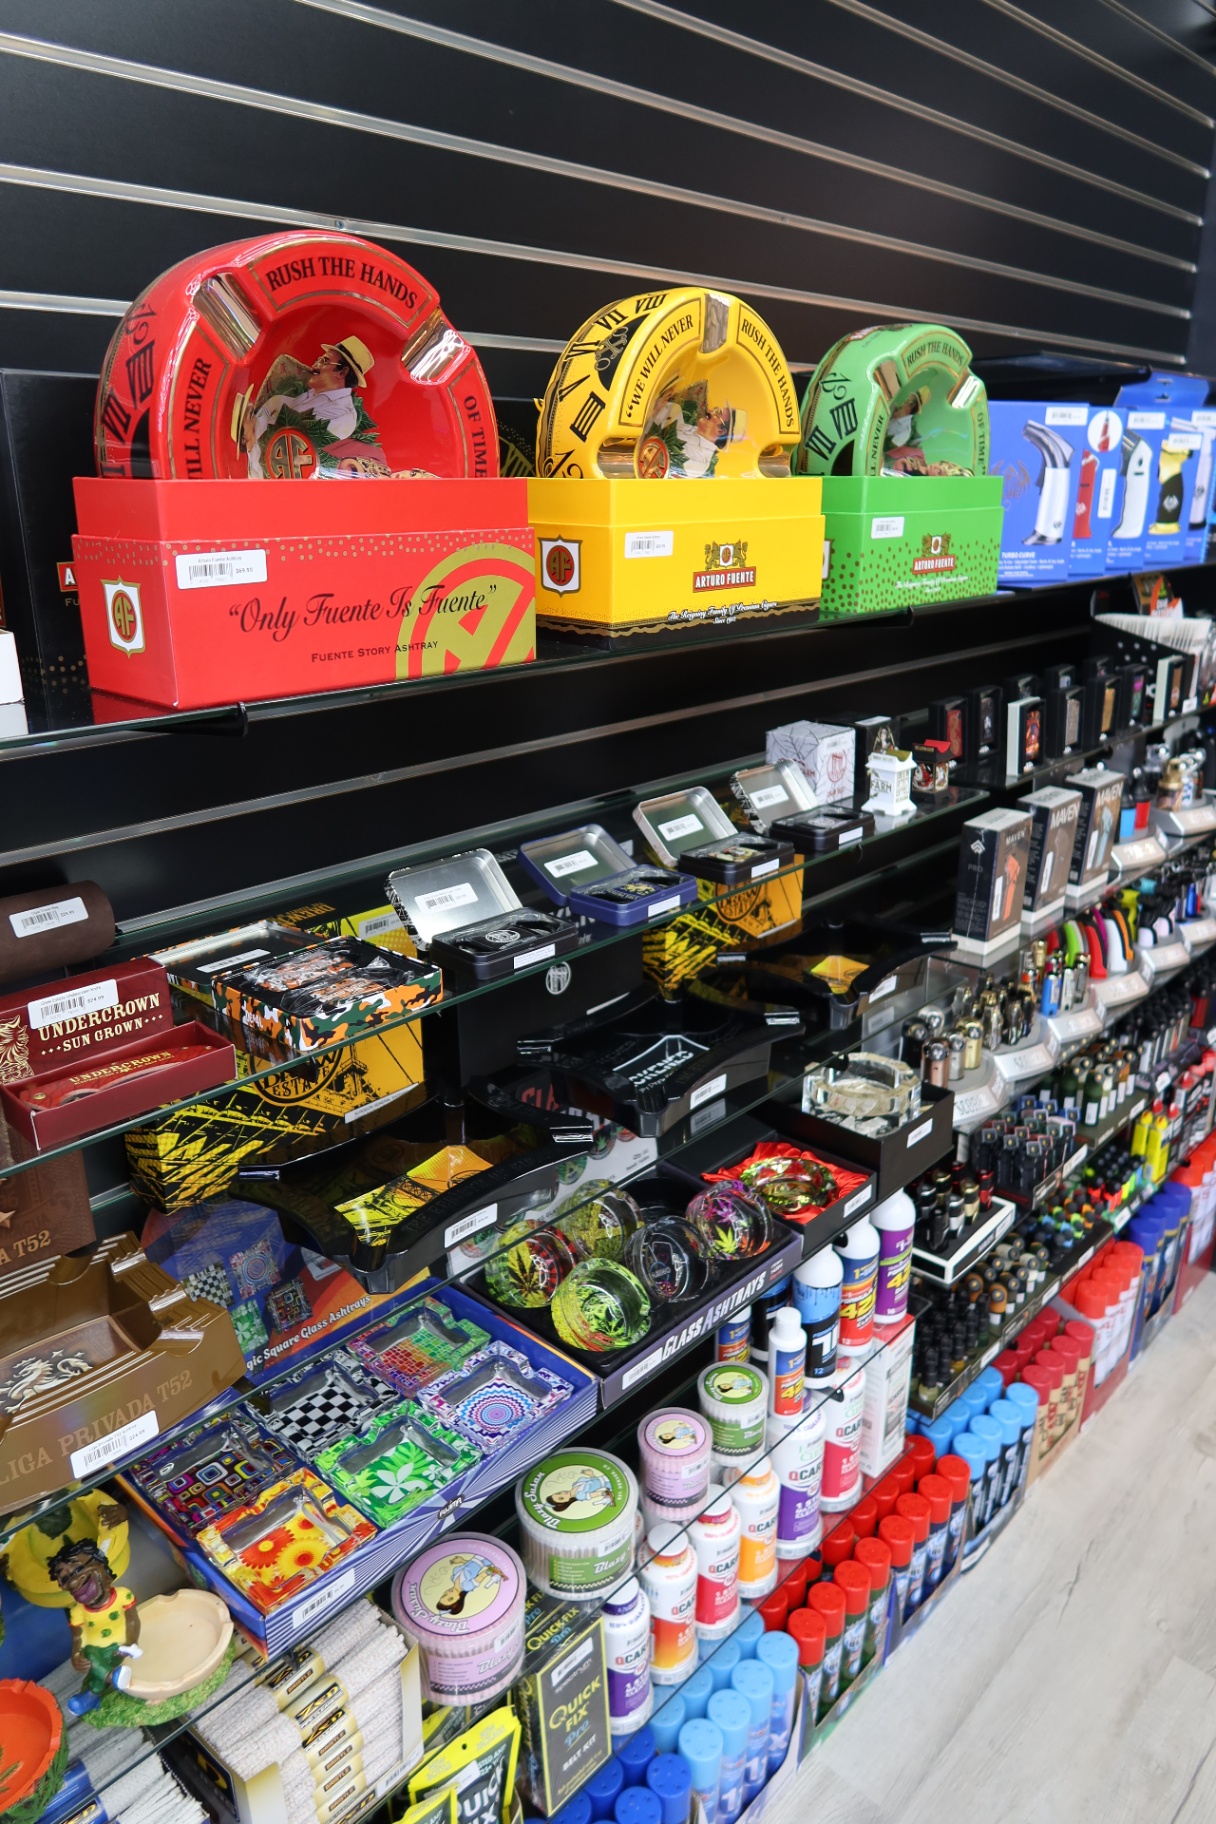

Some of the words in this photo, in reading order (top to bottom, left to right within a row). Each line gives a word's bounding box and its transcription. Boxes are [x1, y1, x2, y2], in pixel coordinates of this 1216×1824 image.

[265, 257, 316, 291] RUSH
[318, 256, 356, 279] THE
[360, 262, 418, 310] HANDS
[640, 346, 664, 380] WILL
[661, 314, 694, 349] NEVER
[906, 344, 927, 367] RUSH
[927, 340, 942, 355] THE
[942, 342, 964, 366] HANDS
[741, 318, 767, 351] RUSH
[766, 344, 782, 372] THE
[777, 375, 795, 427] HANDS
[185, 358, 212, 433] NEVER
[463, 395, 482, 421] OF
[695, 573, 725, 589] ARTURO
[726, 570, 754, 585] FUENTE
[914, 559, 934, 571] ARTURO
[934, 557, 954, 569] FUENTE
[113, 597, 135, 638] AF
[229, 596, 300, 643] “Only
[303, 592, 384, 626] Fuente
[386, 585, 414, 619] Is
[418, 584, 498, 615] Fuente”
[311, 650, 354, 663] FUENTE
[357, 645, 391, 658] STORY
[394, 640, 438, 653] ASHTRAY
[870, 779, 892, 793] FARM
[1096, 781, 1124, 804] MAVEN
[1050, 801, 1080, 828] MAVEN
[1005, 831, 1025, 845] MAVEN
[967, 864, 983, 873] PRO
[38, 993, 161, 1042] UNDERCROWN
[63, 1033, 92, 1053] SUN
[94, 1017, 144, 1042] GROWN
[68, 1050, 173, 1085] UNDERCROWN
[13, 1229, 51, 1260] T52
[662, 1315, 704, 1361] GLASS
[701, 1270, 767, 1335] ASHTRAYS
[246, 1354, 264, 1371] gic
[263, 1335, 300, 1359] Square
[300, 1319, 328, 1339] Glass
[329, 1295, 371, 1323] Ashtrays
[814, 1367, 824, 1375] 12
[58, 1398, 156, 1452] PRIVADA
[156, 1369, 193, 1402] T52
[524, 1471, 546, 1503] Susan
[533, 1502, 561, 1529] Blazy
[593, 1552, 626, 1574] Blazy
[429, 1614, 471, 1633] Blazy
[527, 1618, 565, 1651] QUICK
[563, 1607, 580, 1627] FIX
[549, 1676, 601, 1730] QUICK
[564, 1719, 590, 1748] Pro
[565, 1708, 589, 1733] FIX
[562, 1752, 582, 1772] BELT
[582, 1733, 597, 1753] KIT
